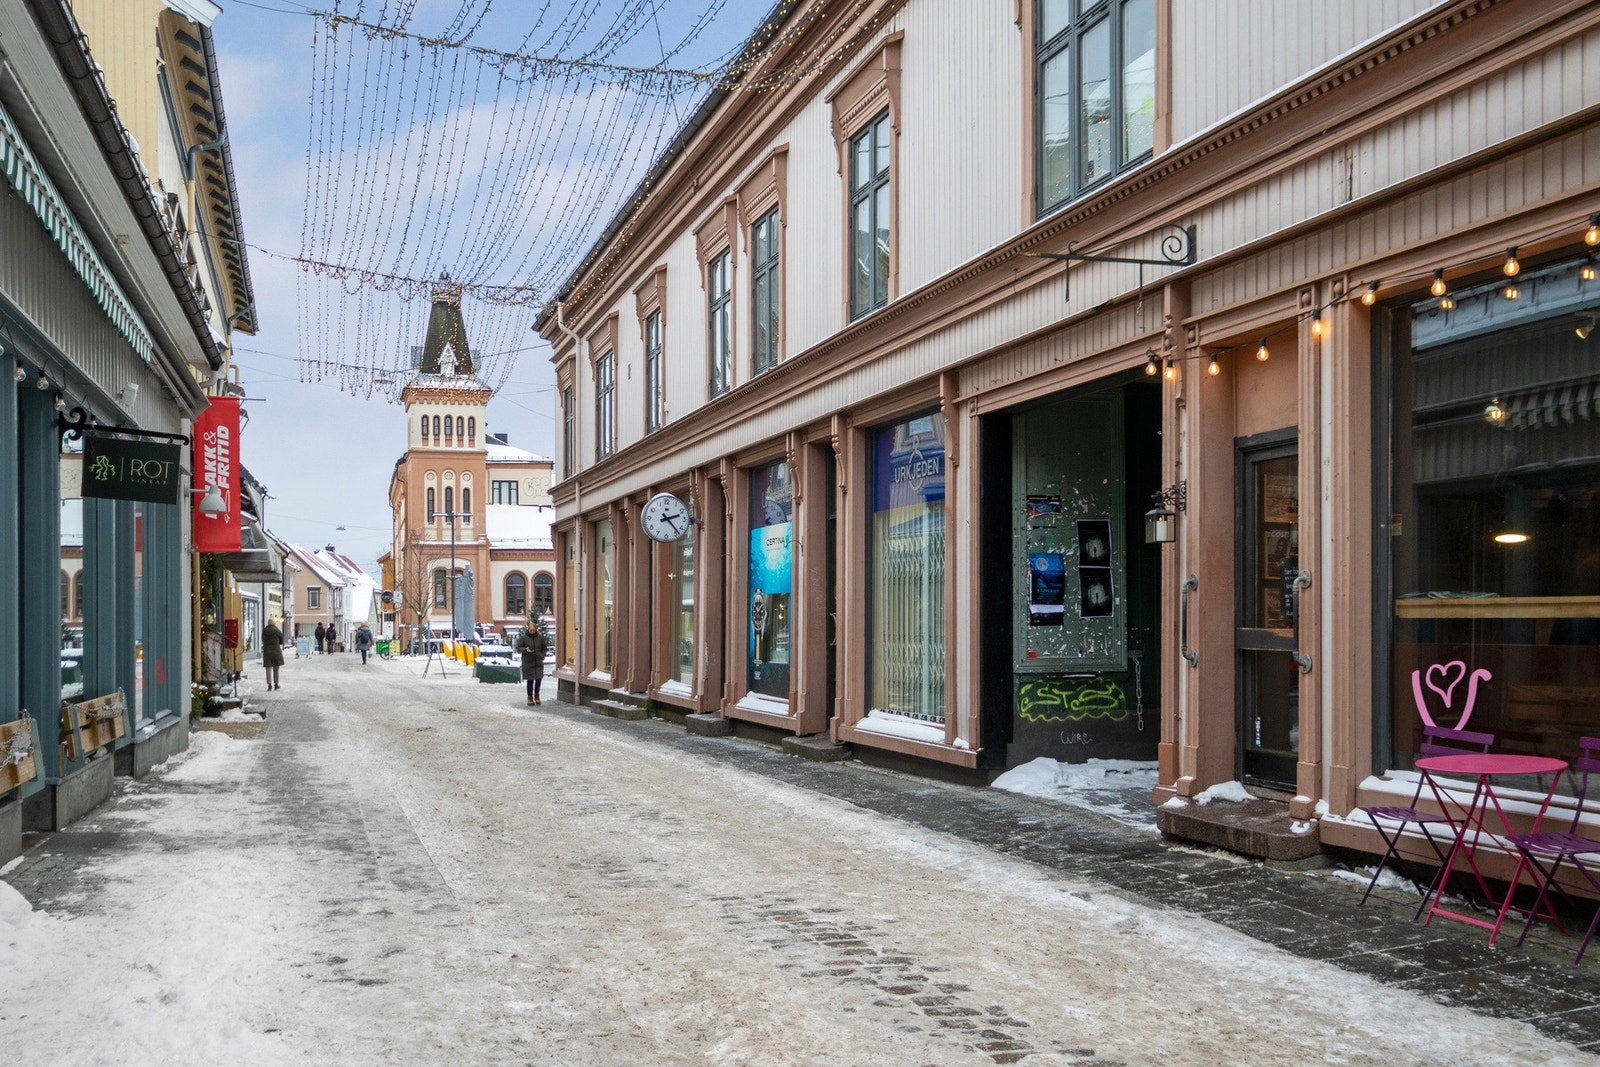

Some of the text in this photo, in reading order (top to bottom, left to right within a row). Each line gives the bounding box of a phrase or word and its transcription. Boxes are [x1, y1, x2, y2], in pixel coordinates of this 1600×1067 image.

[203, 431, 217, 445] &
[130, 458, 174, 479] ROT
[217, 425, 230, 489] FRITID
[894, 457, 939, 483] URKJEDEN
